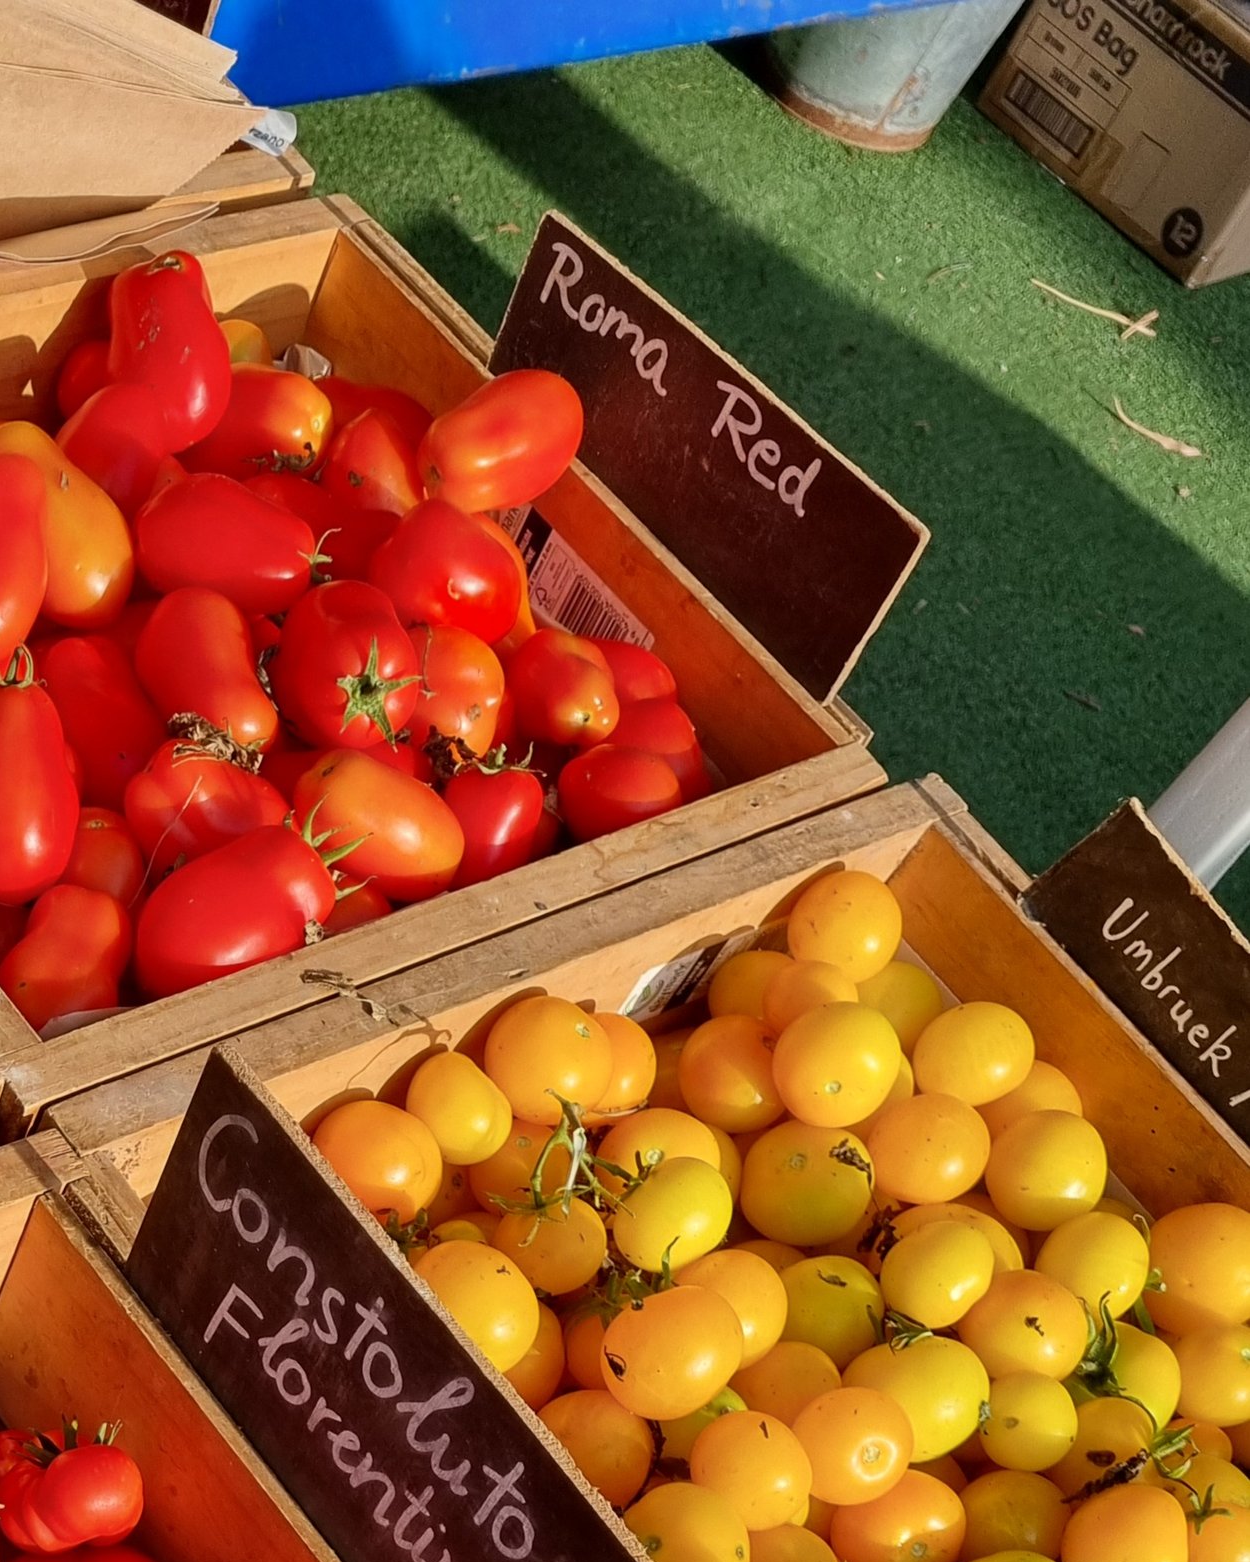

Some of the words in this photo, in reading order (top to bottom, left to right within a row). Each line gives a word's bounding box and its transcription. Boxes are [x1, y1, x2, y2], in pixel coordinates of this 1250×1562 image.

[1092, 18, 1139, 76] Bag
[540, 242, 669, 397] Roma
[711, 380, 822, 518] Red
[197, 1113, 536, 1560] Constoluto
